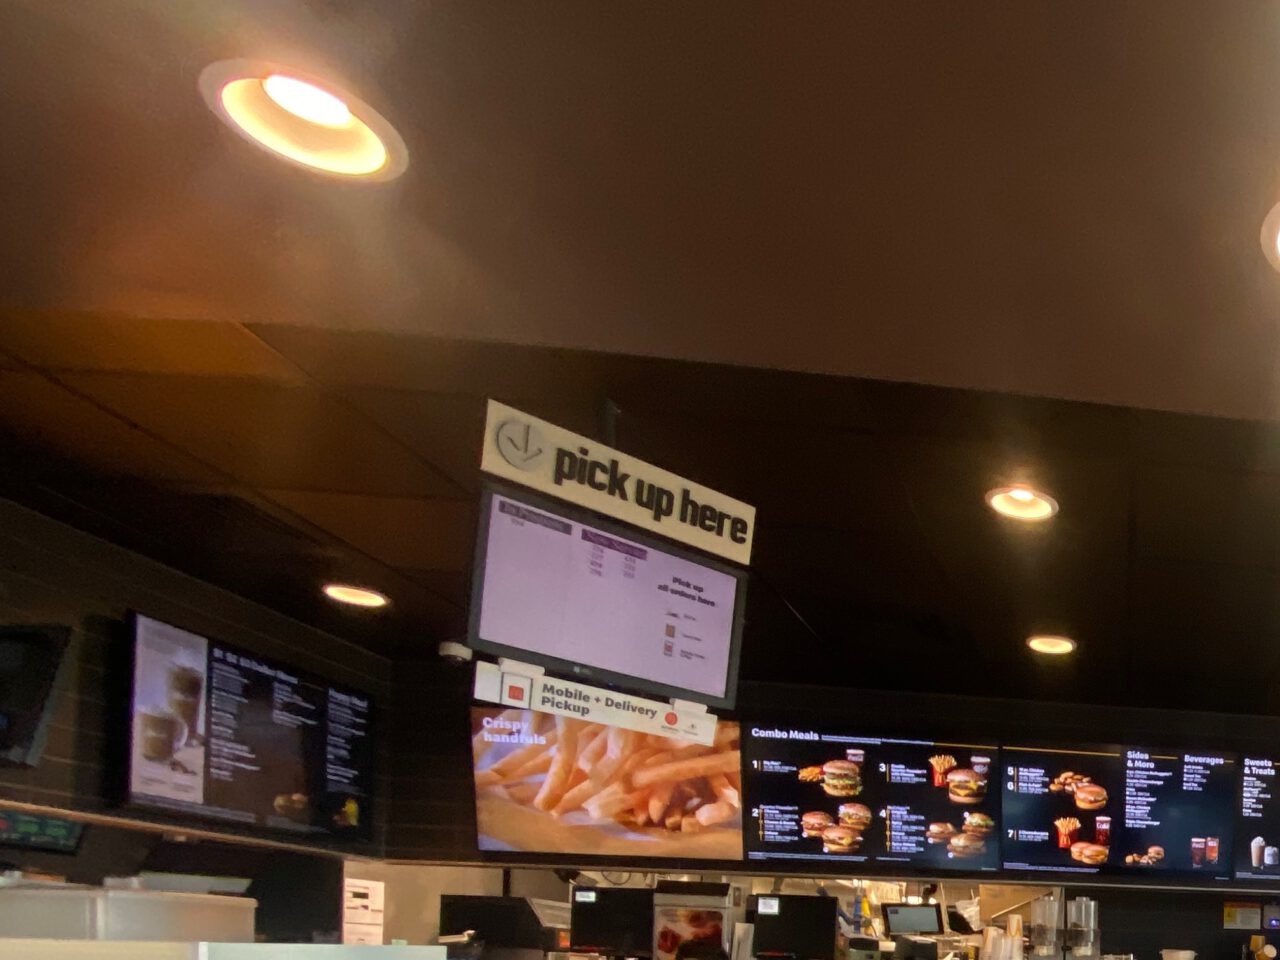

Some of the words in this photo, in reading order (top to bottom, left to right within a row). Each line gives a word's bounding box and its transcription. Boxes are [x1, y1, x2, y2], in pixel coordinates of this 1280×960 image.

[553, 447, 630, 501] pick
[635, 479, 674, 522] up
[679, 488, 748, 544] here
[672, 576, 692, 589] Pick
[542, 683, 591, 703] Mobile
[604, 697, 657, 718] Delivery
[541, 696, 590, 717] Pickup
[482, 717, 530, 733] Crispy
[483, 731, 546, 745] handfuls
[752, 728, 788, 739] Combo
[789, 730, 819, 740] Meals
[1126, 751, 1149, 760] Sides
[1184, 754, 1224, 765] Beverages
[752, 760, 758, 769] 1
[1134, 760, 1155, 768] More
[1244, 758, 1272, 767] Sweets
[879, 763, 886, 772] 3
[1007, 767, 1014, 775] 5
[1252, 767, 1276, 776] Treats
[1007, 782, 1014, 790] 6
[752, 808, 759, 817] 2
[879, 809, 886, 818] 4
[1007, 830, 1014, 838] 7
